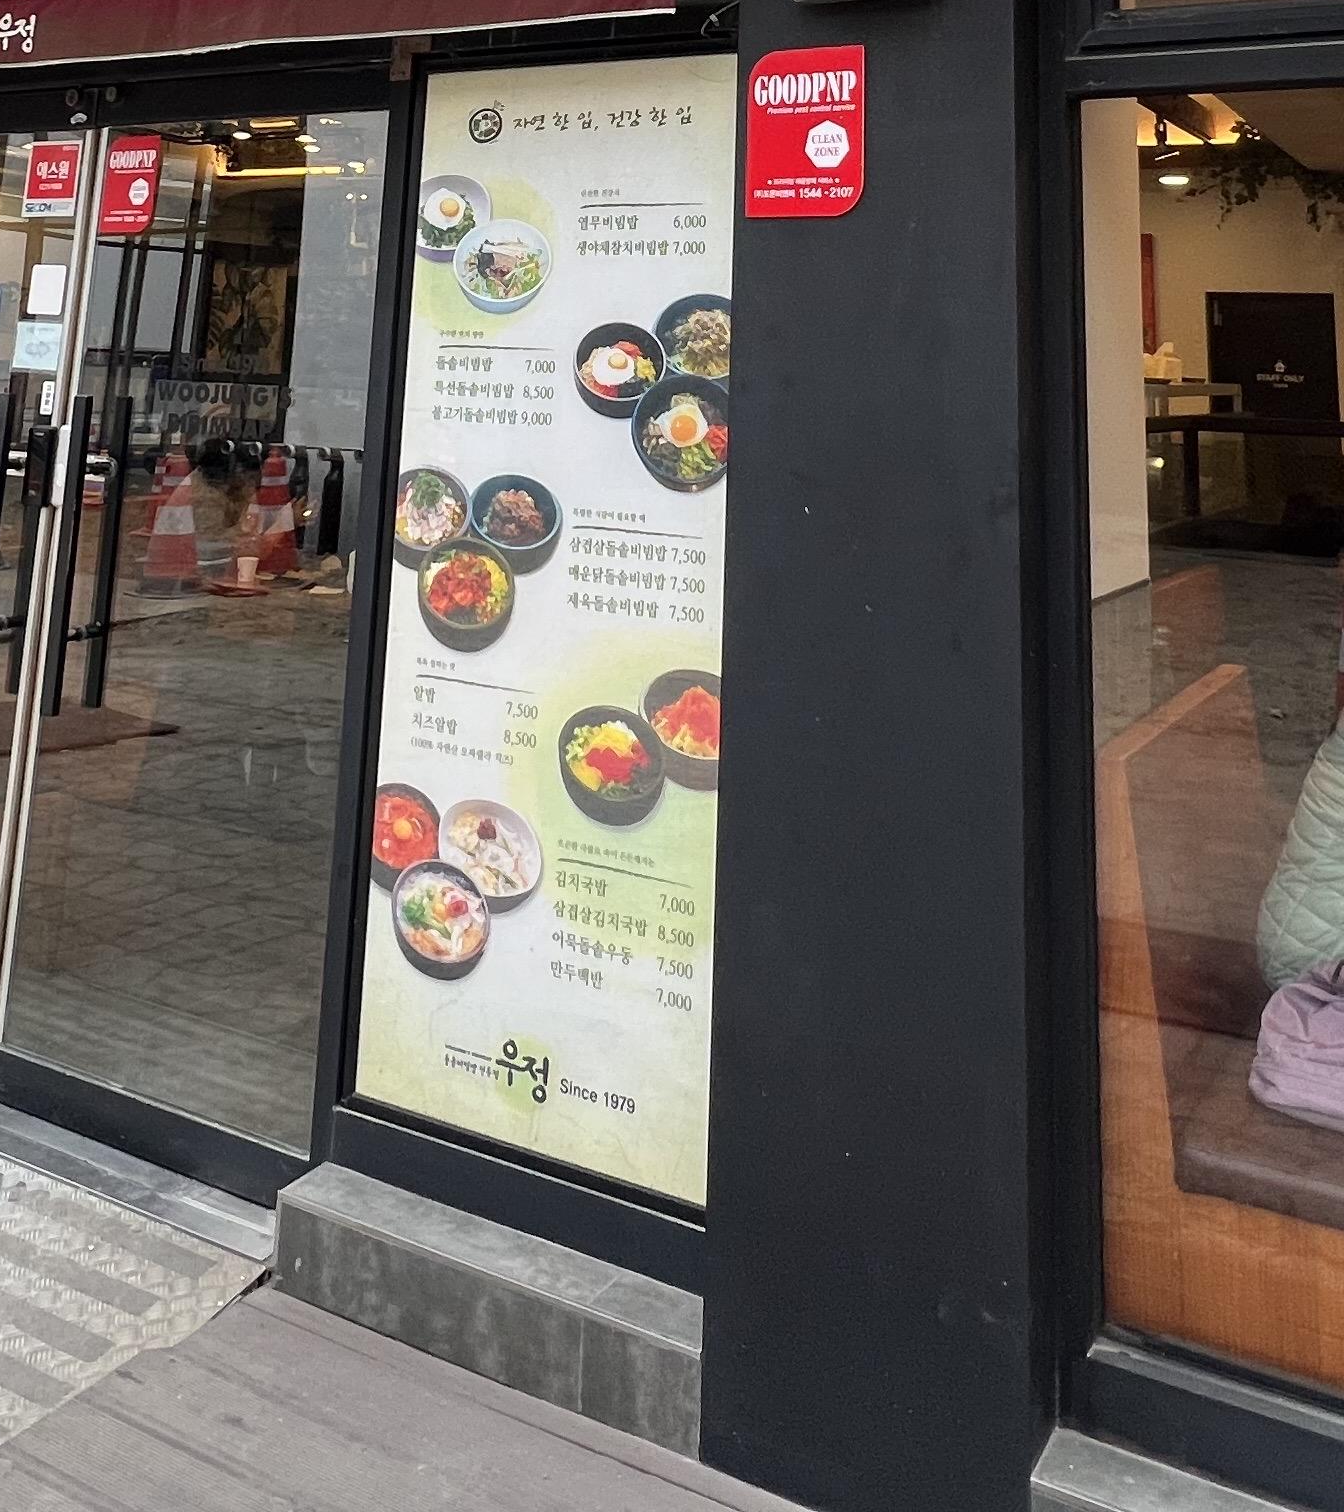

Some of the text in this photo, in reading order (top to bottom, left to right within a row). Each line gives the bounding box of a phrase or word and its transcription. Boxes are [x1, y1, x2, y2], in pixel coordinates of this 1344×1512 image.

[754, 70, 857, 106] GOODPNP
[513, 105, 692, 131] 자연 한 입, 건강 한 입
[811, 133, 843, 144] CLEAN
[814, 146, 840, 157] ZONE
[36, 160, 71, 180] 에스원
[578, 215, 707, 230] 열무비빔밥 6,000
[672, 240, 706, 256] 7,000
[435, 356, 556, 375] 돌솥비빔밥 7,000
[522, 385, 554, 400] 8,500
[521, 410, 553, 426] 9,000
[671, 547, 706, 565] 7,500
[670, 576, 705, 594] 7,500
[669, 605, 705, 623] 7,500
[413, 685, 539, 719] 알밥 7,500
[412, 711, 537, 748] 치즈알밥 8,500
[555, 870, 695, 916] 김치국밥 7,000
[553, 900, 695, 948] 삼겹살김치국밥 8,500
[657, 956, 694, 979] 7,500
[655, 988, 692, 1012] 7,000
[496, 1039, 549, 1104] 우정
[560, 1078, 598, 1103] Since
[603, 1091, 636, 1114] 1979
